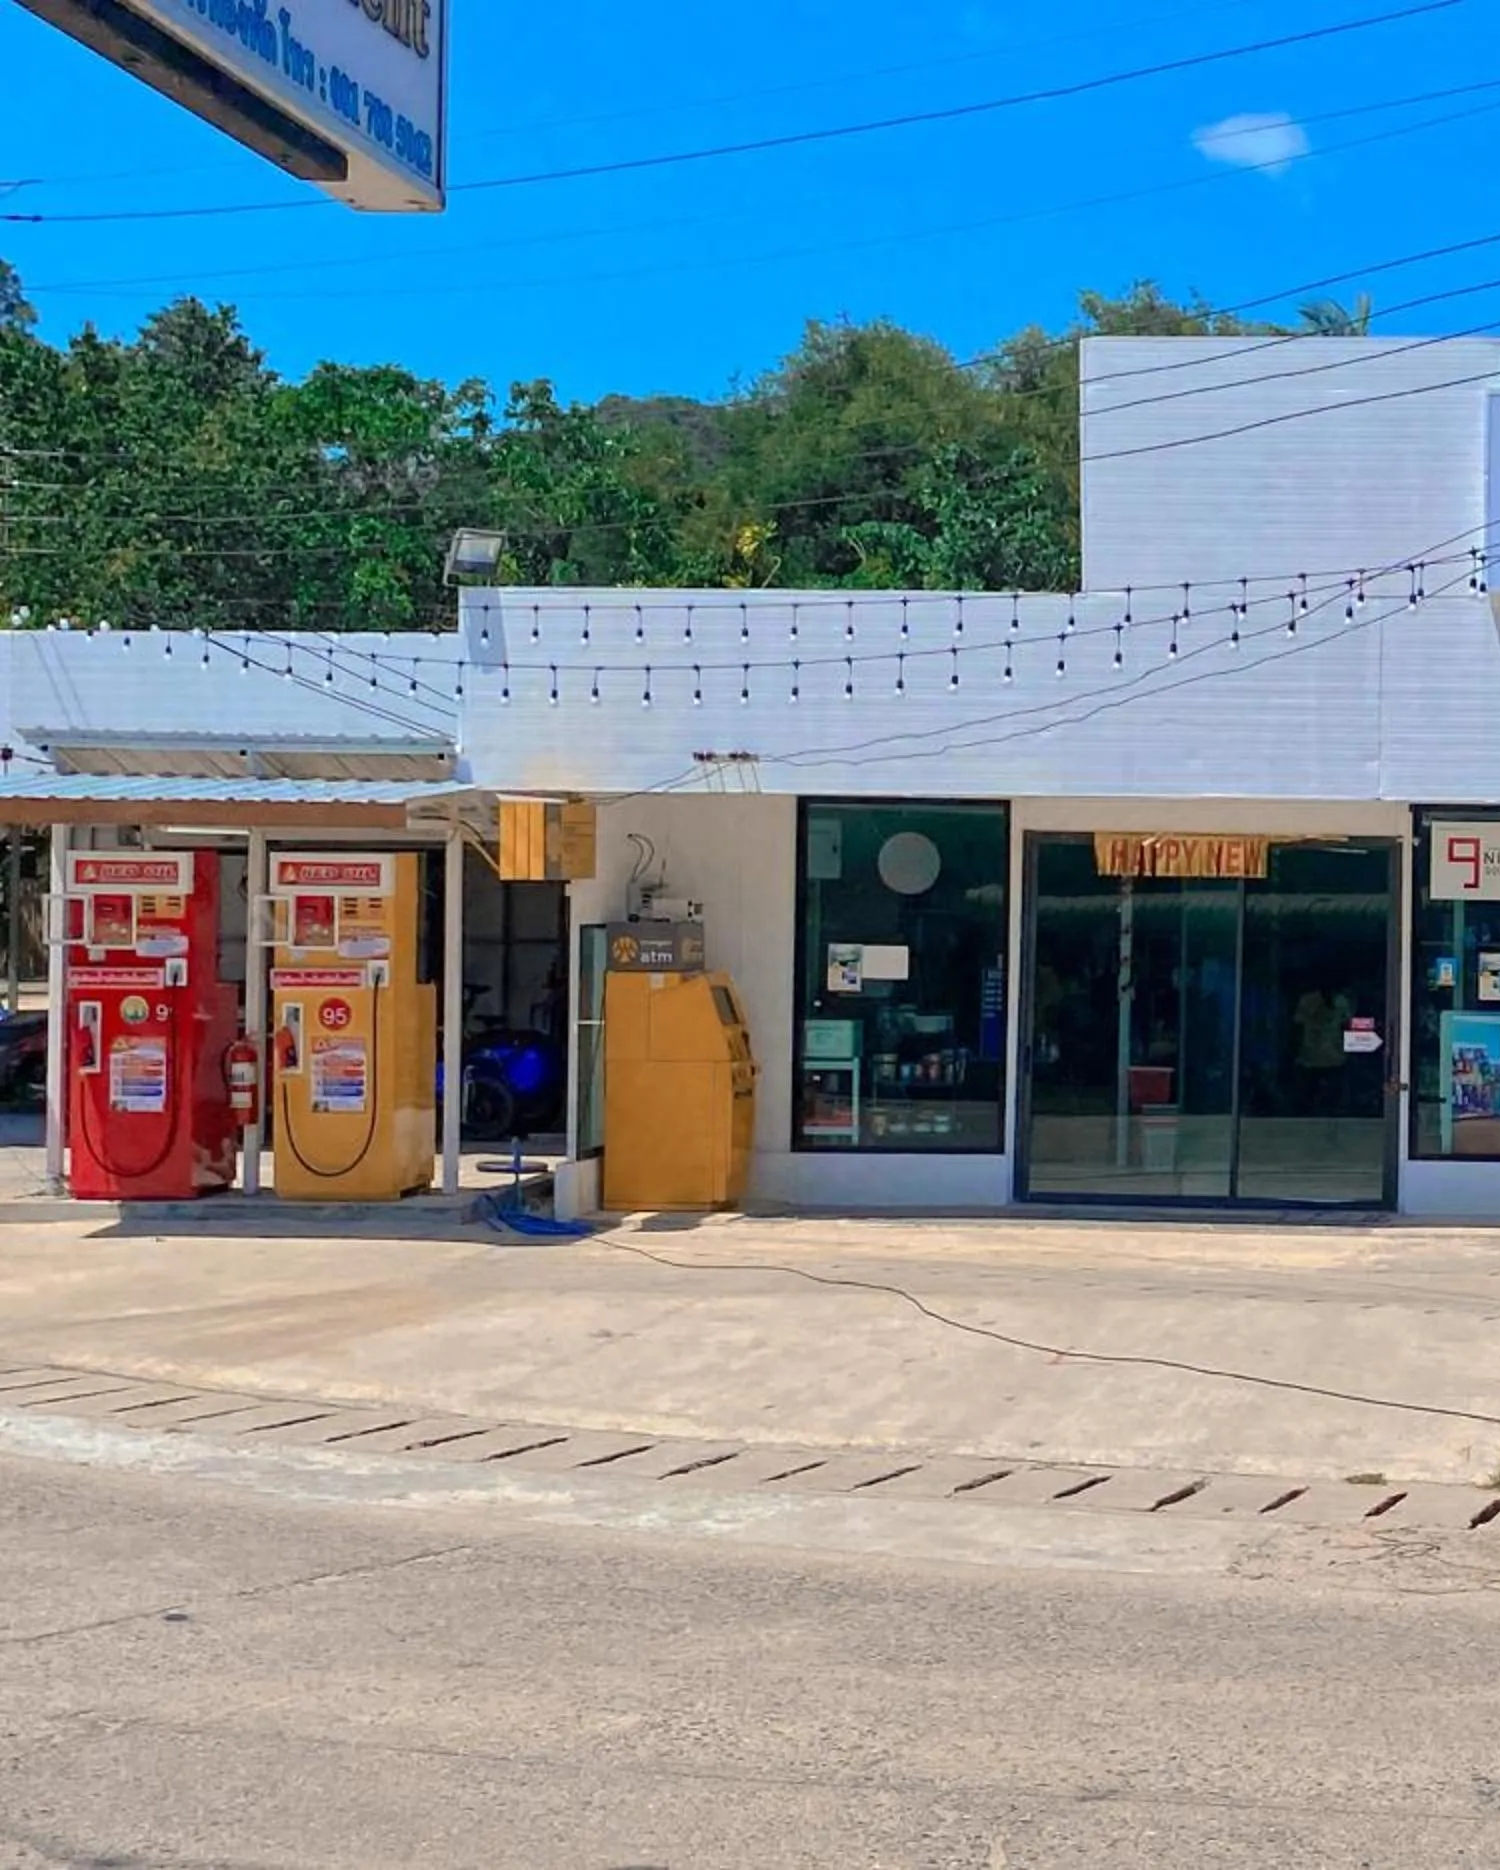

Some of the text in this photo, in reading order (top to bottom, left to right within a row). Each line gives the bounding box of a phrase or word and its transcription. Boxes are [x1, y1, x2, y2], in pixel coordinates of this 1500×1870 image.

[1110, 838, 1264, 876] HAPPY NEW
[1448, 838, 1480, 889] 9
[641, 950, 674, 963] atm
[155, 1003, 173, 1022] 9
[321, 1006, 348, 1026] 95
